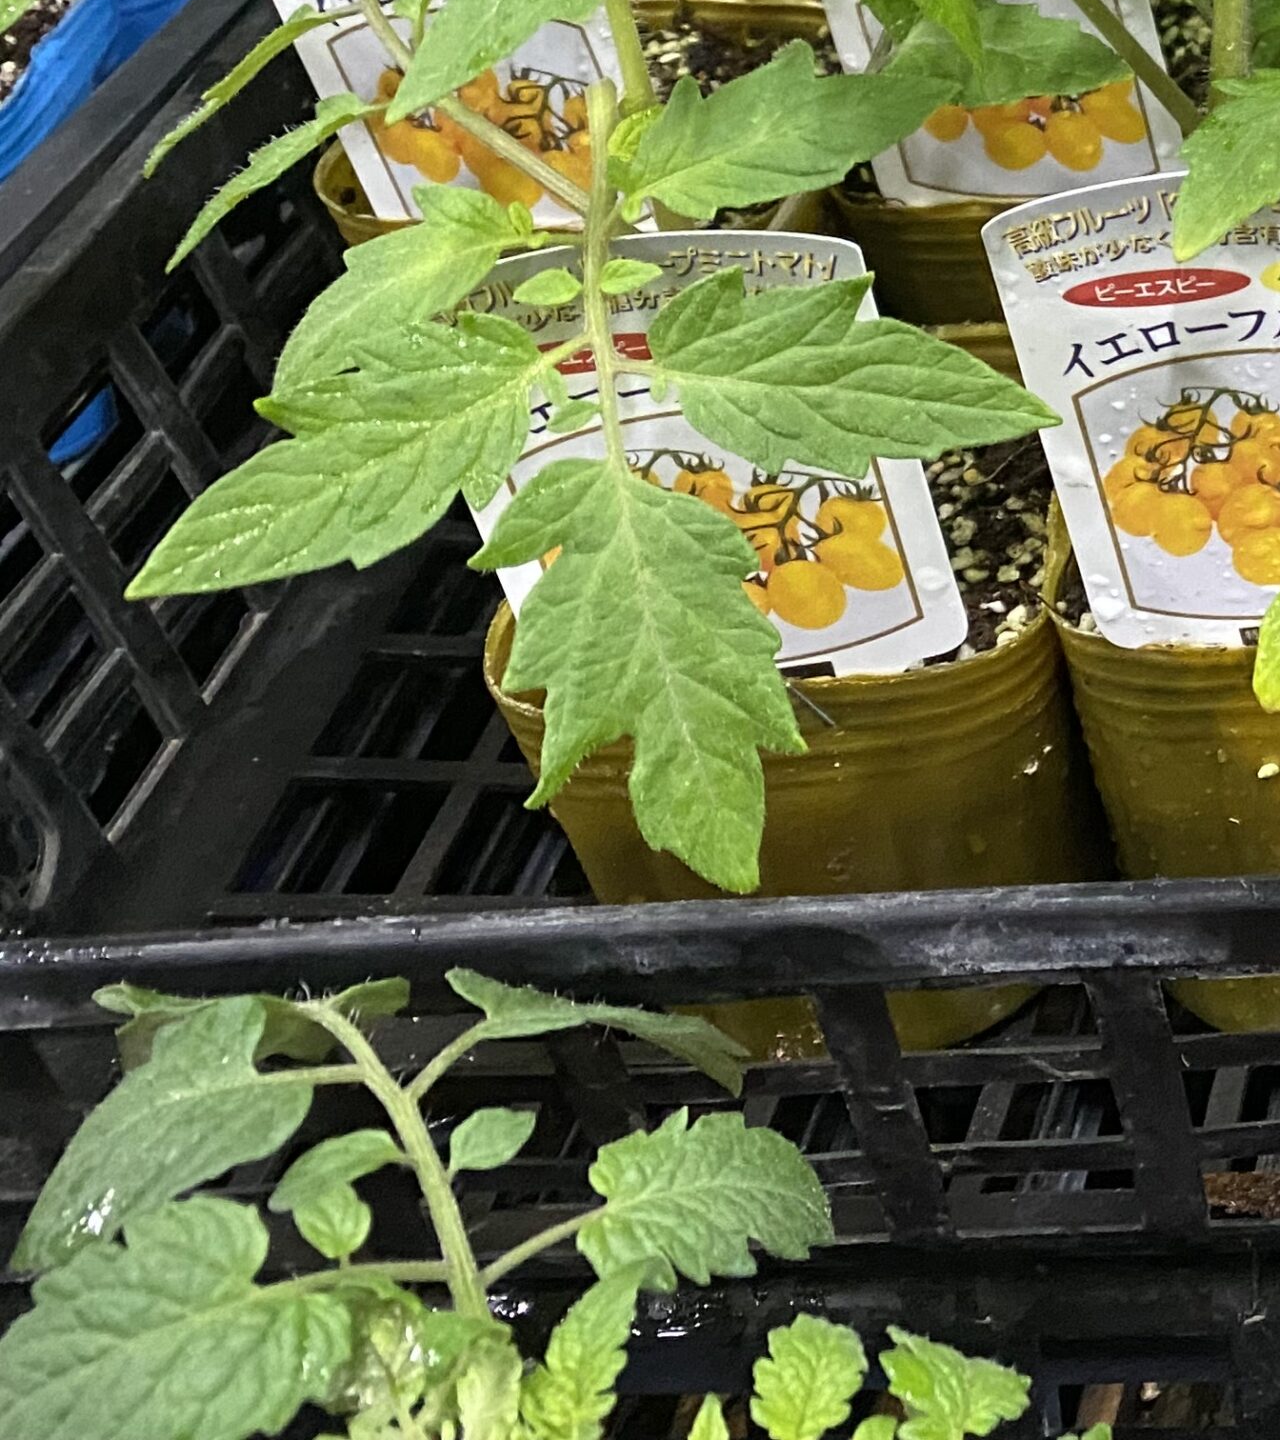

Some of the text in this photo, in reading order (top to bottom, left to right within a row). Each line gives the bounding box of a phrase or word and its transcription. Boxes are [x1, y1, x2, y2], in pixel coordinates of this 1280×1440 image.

[1094, 274, 1217, 303] ピーエスピー
